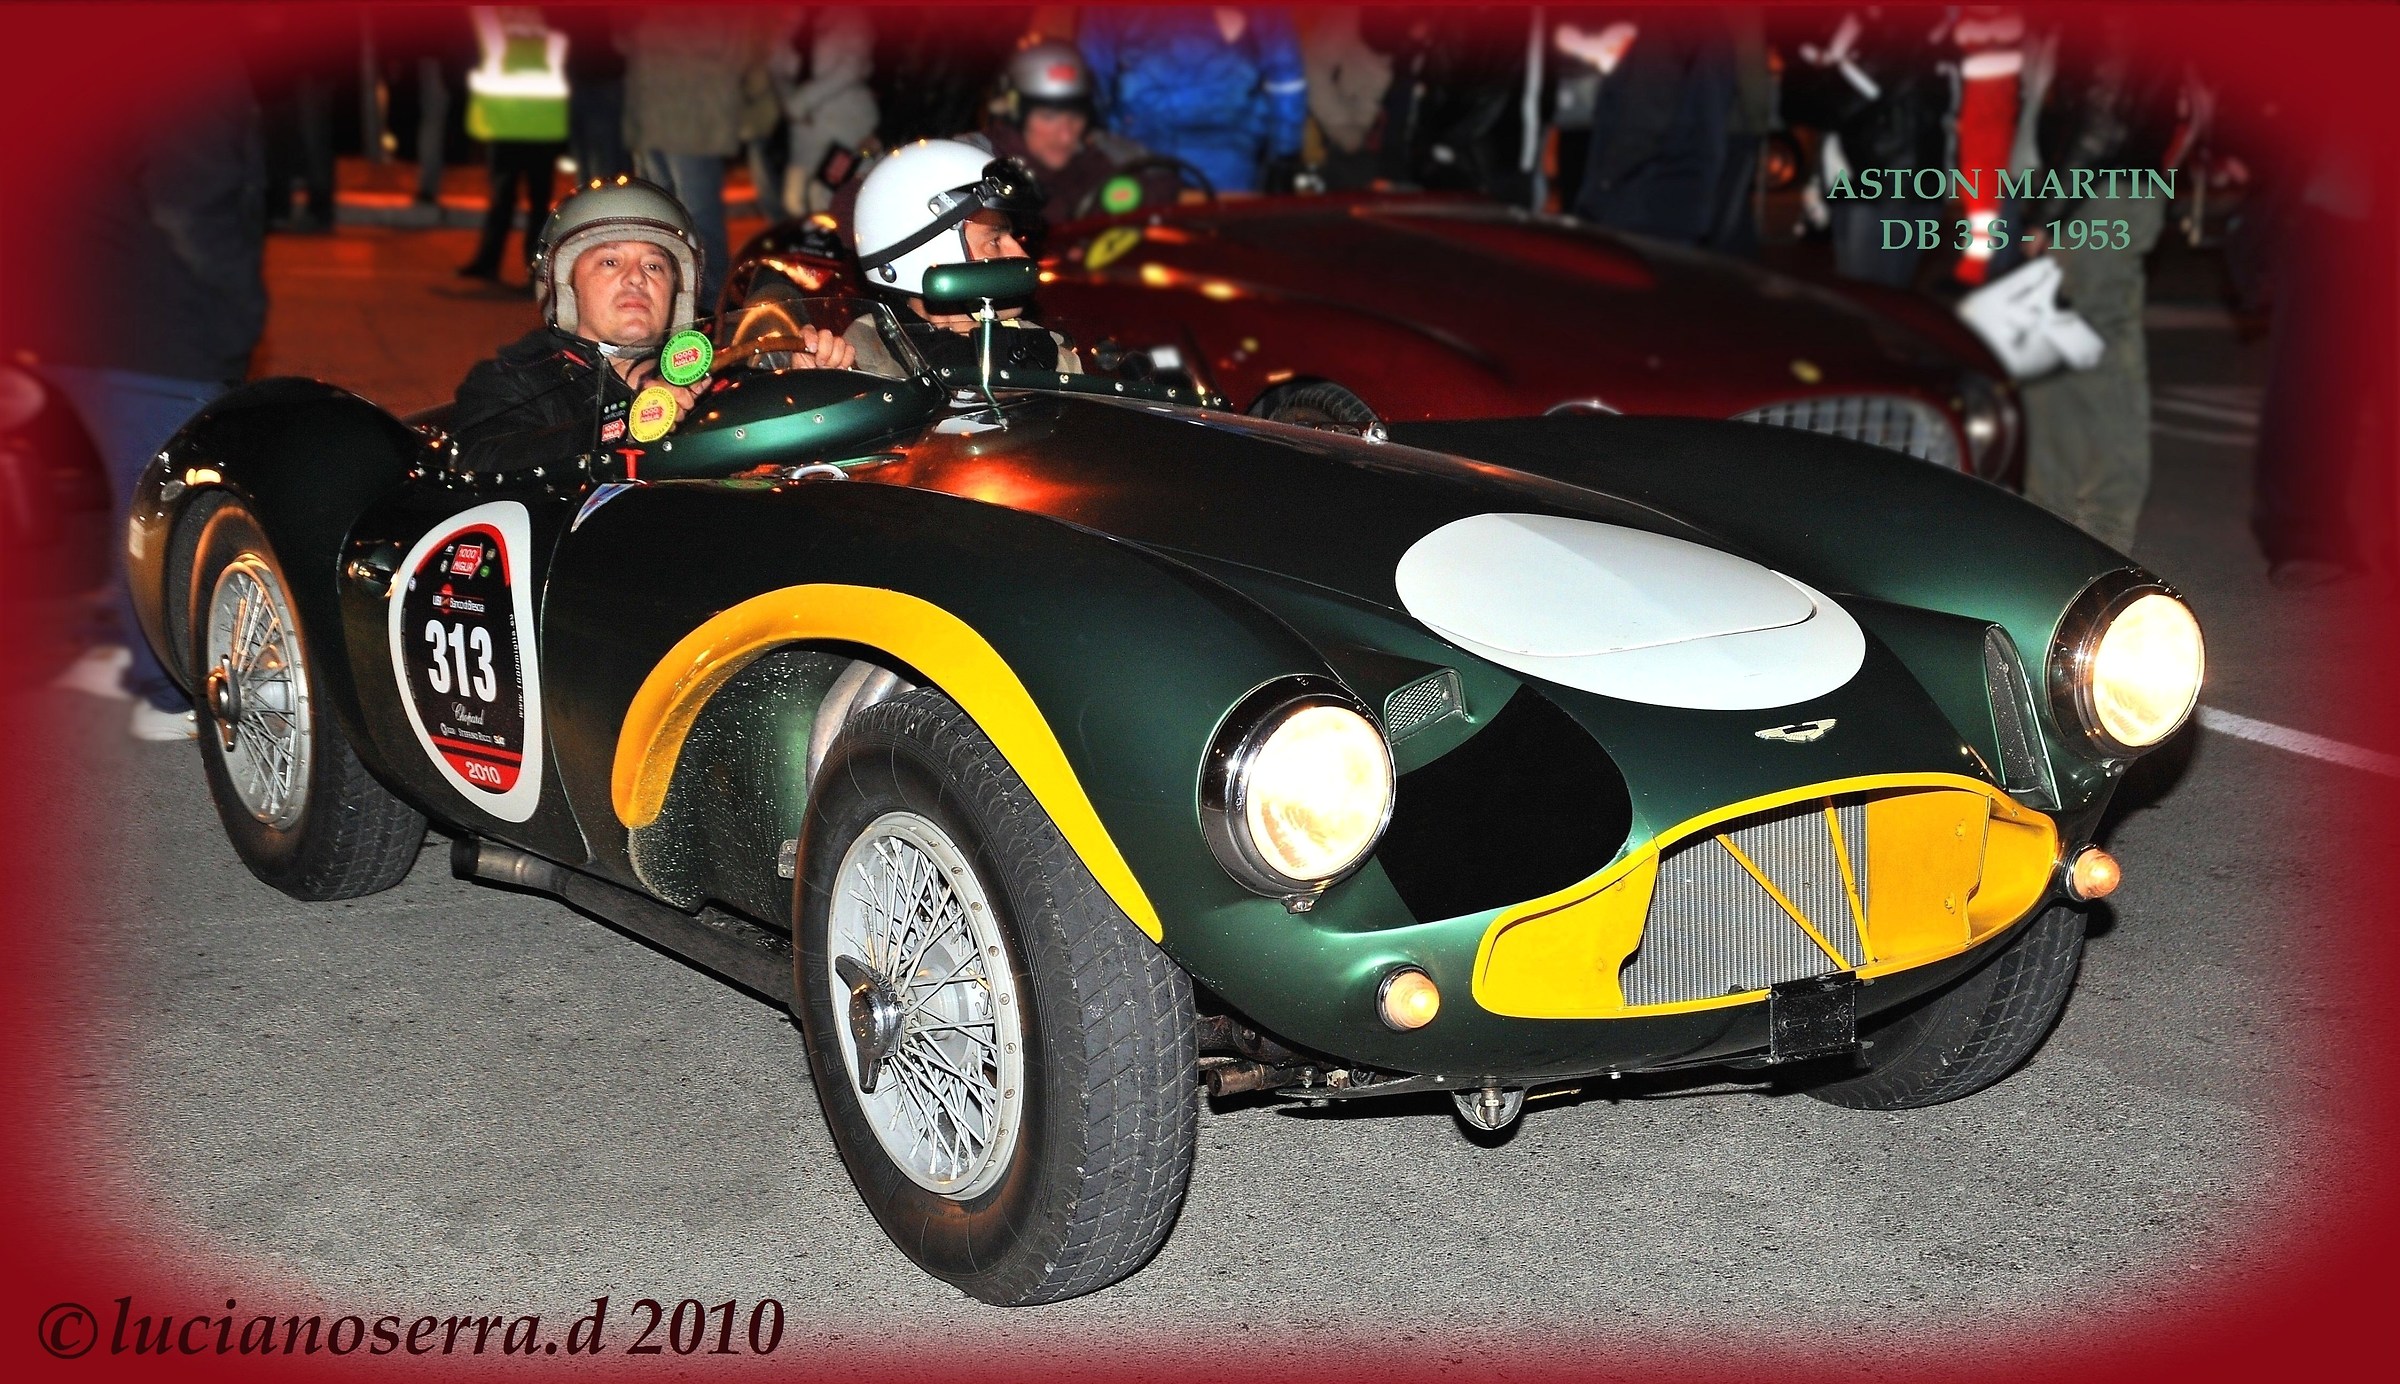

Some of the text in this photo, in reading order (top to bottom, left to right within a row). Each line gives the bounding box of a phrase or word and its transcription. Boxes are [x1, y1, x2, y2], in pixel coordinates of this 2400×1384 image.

[674, 350, 693, 360] 1000
[458, 548, 477, 559] 1000
[452, 561, 475, 572] MIGLIA
[425, 619, 498, 703] 313
[465, 761, 502, 785] 2010
